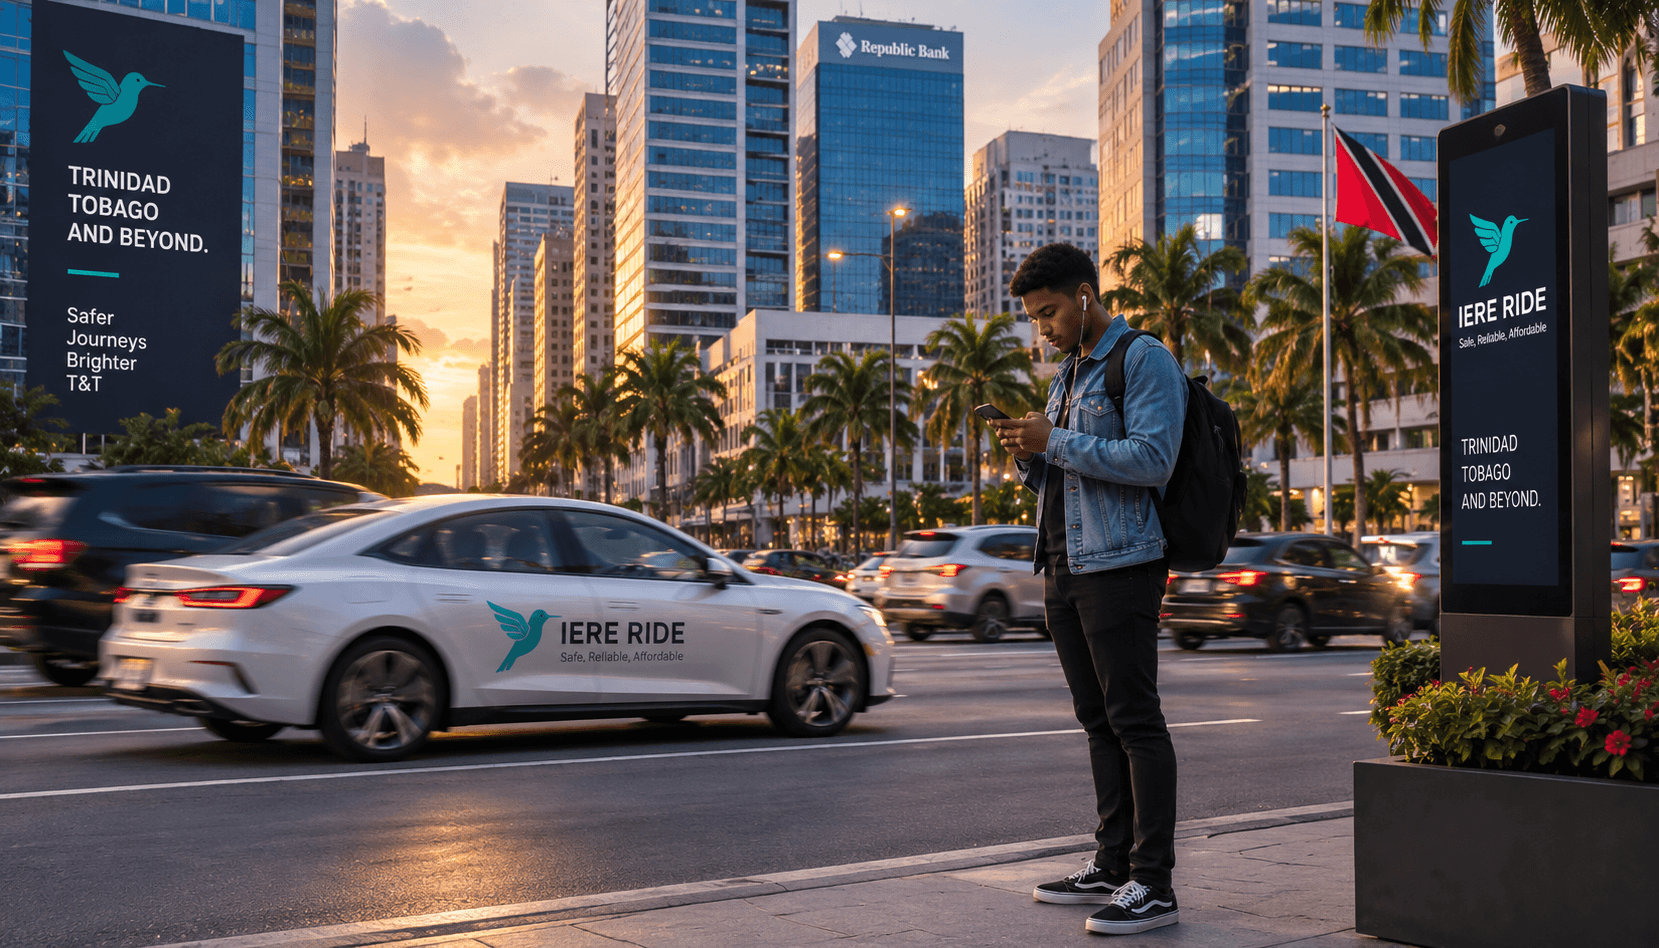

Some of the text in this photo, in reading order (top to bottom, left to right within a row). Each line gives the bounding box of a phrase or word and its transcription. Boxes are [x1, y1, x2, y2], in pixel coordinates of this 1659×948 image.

[861, 40, 950, 60] Republic Bank
[67, 165, 171, 195] TRINIDAD
[67, 193, 159, 221] TOBAGO
[67, 222, 209, 254] AND BEYOND.
[67, 306, 115, 325] Safer
[1458, 286, 1547, 329] IERE RIDE
[66, 329, 147, 353] Journeys
[1508, 321, 1547, 339] Affordable
[67, 351, 138, 373] Brighter
[66, 374, 103, 392] T&T
[1461, 434, 1518, 456] TRINIDAD
[1461, 463, 1511, 483] TOBAGO
[1461, 489, 1542, 510] AND BEYOND.
[560, 621, 685, 645] IERE RIDE
[560, 651, 684, 663] Safe, Reliable, Affordable
